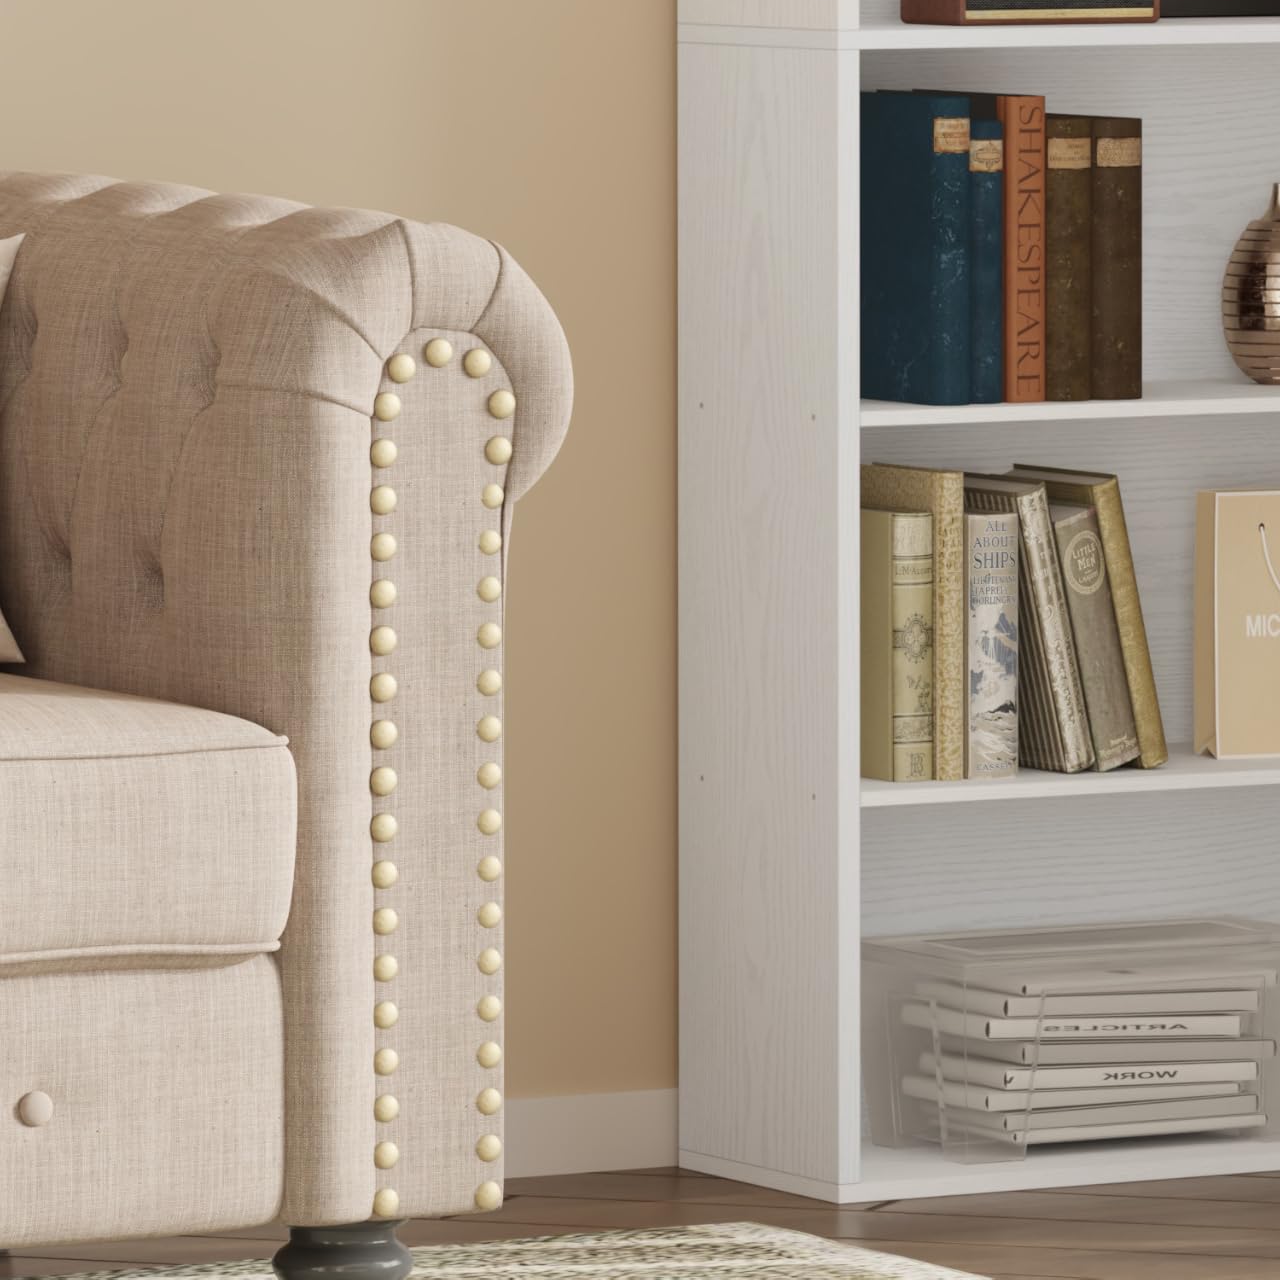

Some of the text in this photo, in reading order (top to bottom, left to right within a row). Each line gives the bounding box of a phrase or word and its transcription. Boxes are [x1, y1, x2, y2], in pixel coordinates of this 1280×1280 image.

[1017, 104, 1042, 397] SHAKESPEARE
[985, 520, 1008, 532] ALL
[1072, 541, 1097, 560] LITTLE
[973, 552, 1017, 570] SHIPS
[1077, 553, 1096, 571] MEN
